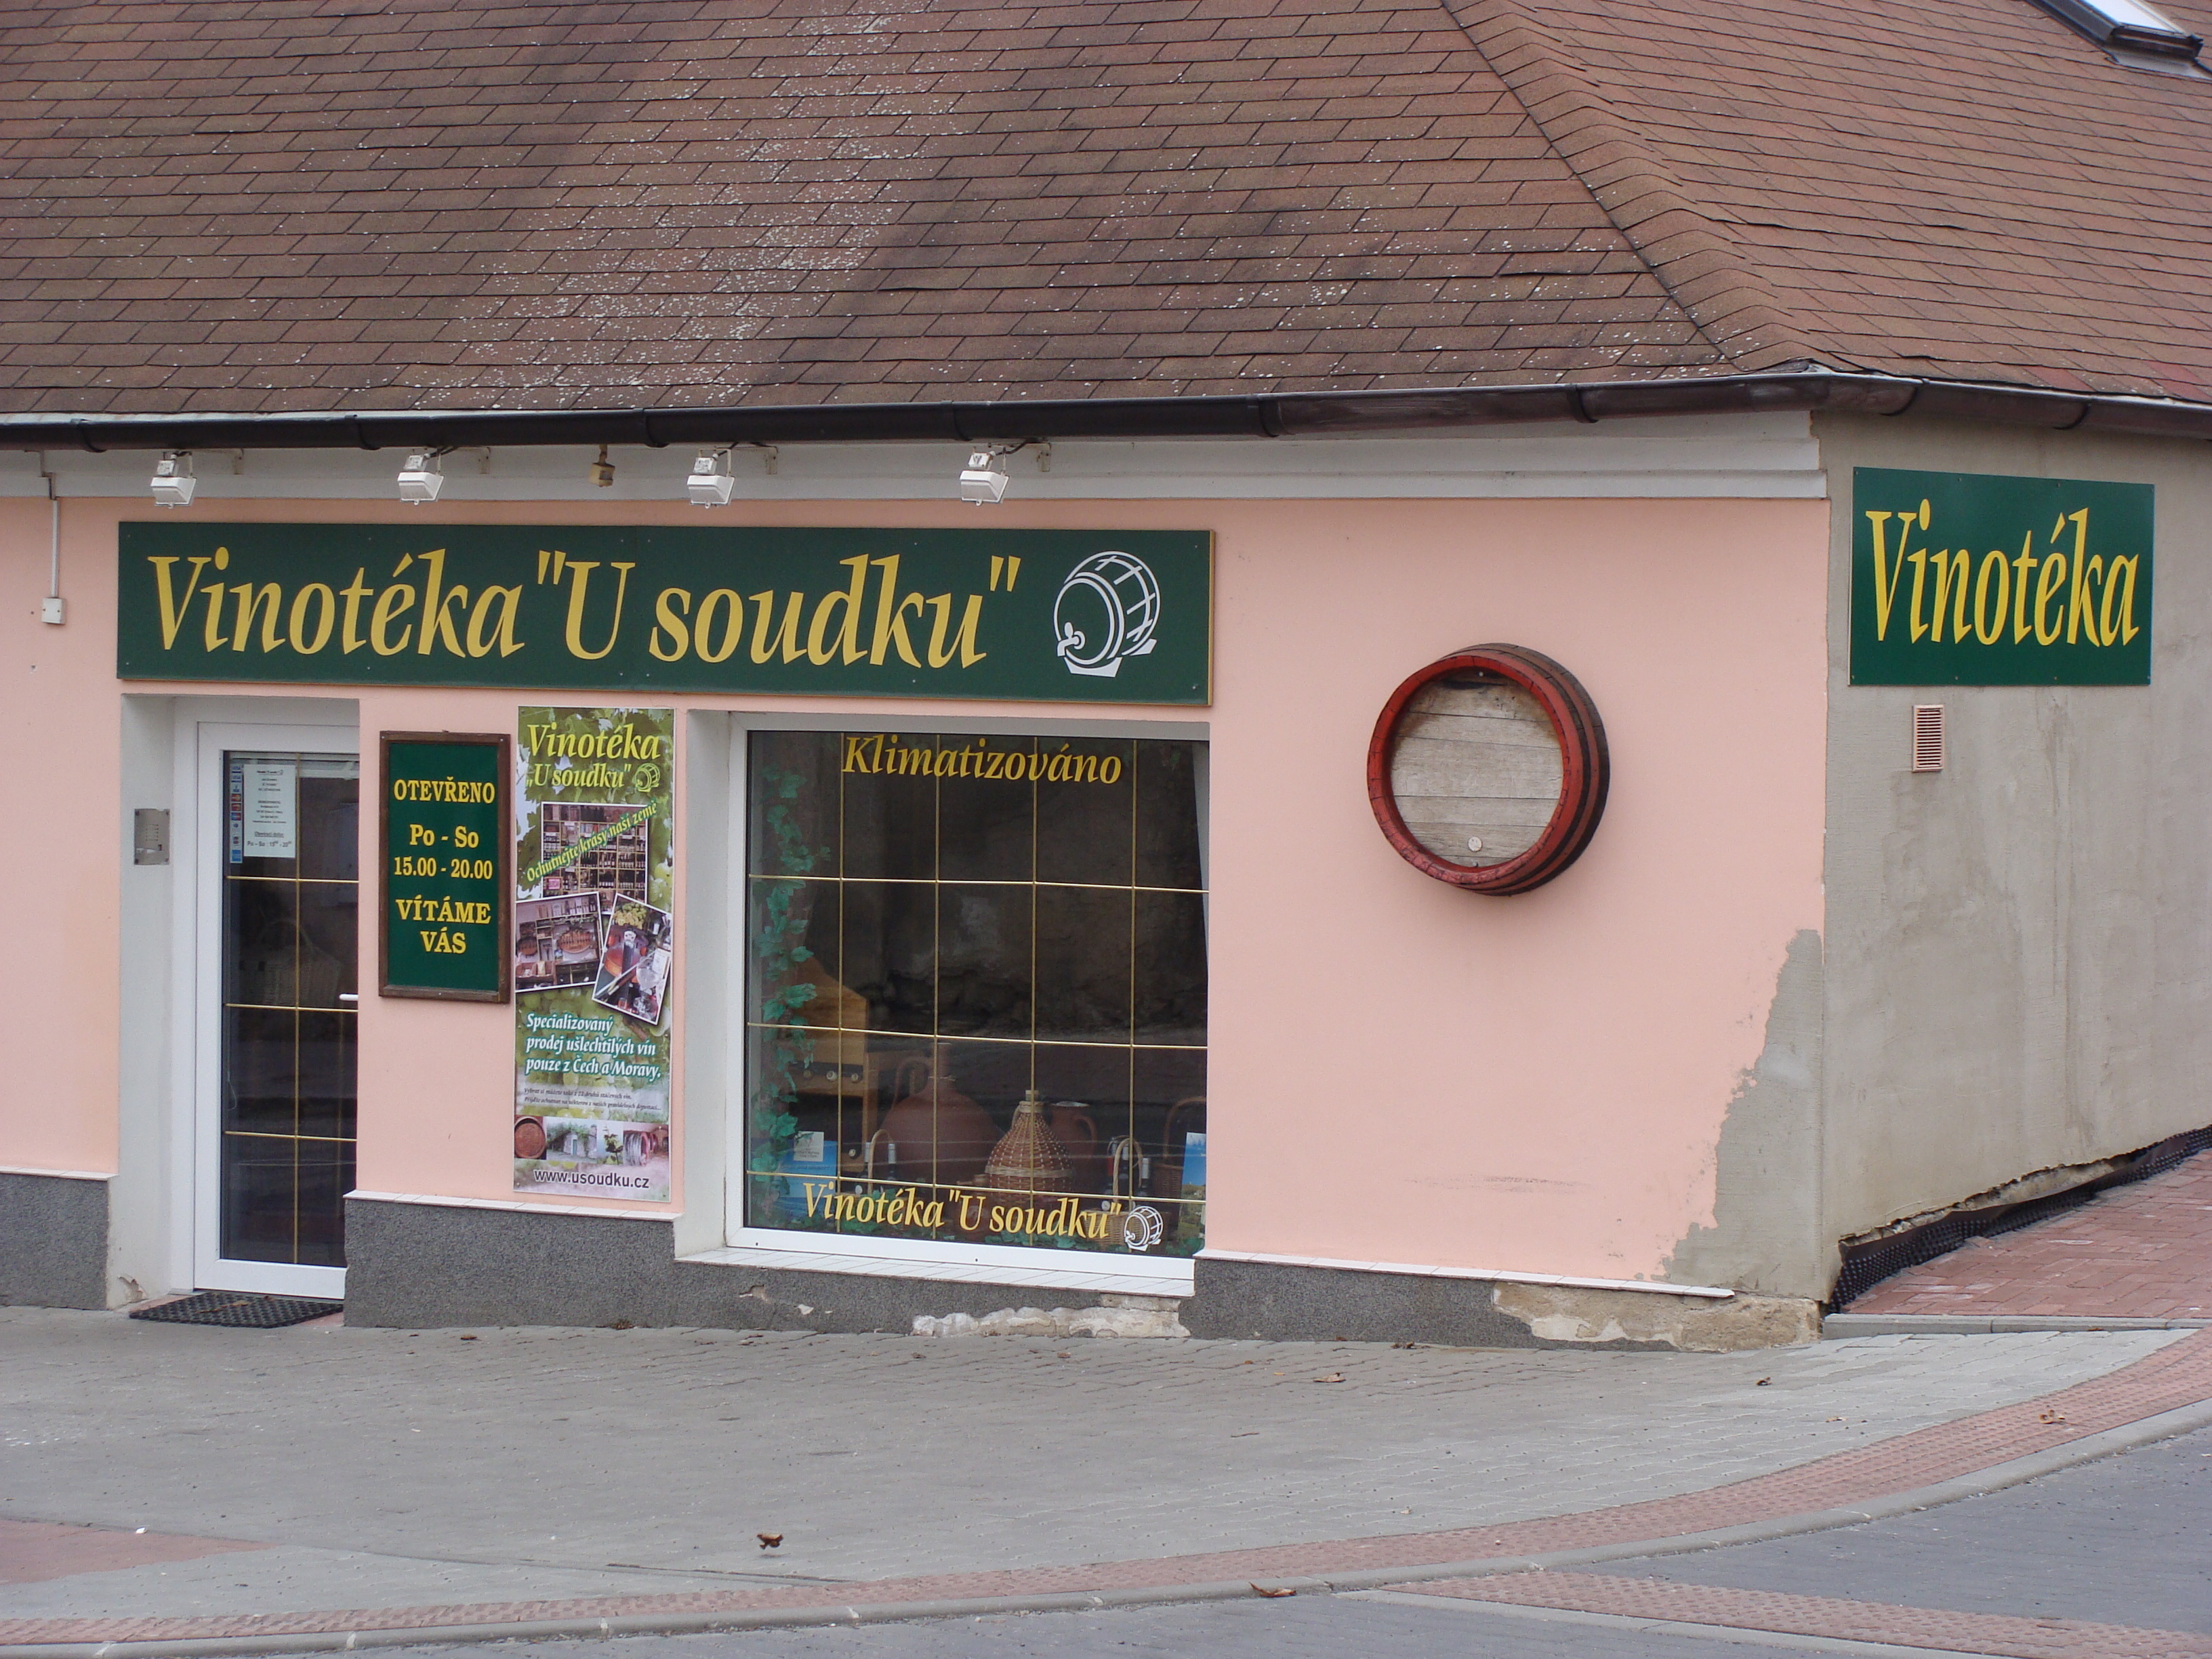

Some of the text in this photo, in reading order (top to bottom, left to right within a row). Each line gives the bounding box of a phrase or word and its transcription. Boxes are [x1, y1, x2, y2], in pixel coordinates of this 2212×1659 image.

[1865, 498, 2139, 647] Vinotéka
[148, 546, 1022, 670] Vinotéka "U soudku"
[527, 722, 661, 760] Vinotéka
[842, 734, 1122, 784] Klimatizováno
[393, 776, 495, 804] OTEVŘENO
[409, 823, 435, 846] Po
[454, 825, 480, 848] So
[527, 844, 579, 882] Ochutnejte
[579, 831, 607, 853] krásy
[632, 799, 657, 824] země
[394, 857, 436, 878] 15.00
[451, 859, 493, 880] 20.00
[396, 895, 492, 925] VÍTÁME
[420, 926, 467, 954] VÁS
[527, 1013, 613, 1036] Specializovaný
[526, 1034, 656, 1058] prodej ušlechtilých vín
[525, 1054, 661, 1081] pouze z Čech a Moravy.
[535, 1169, 650, 1188] www.usoudku.cz
[803, 1181, 1122, 1240] Vinotéka "U soudku"
